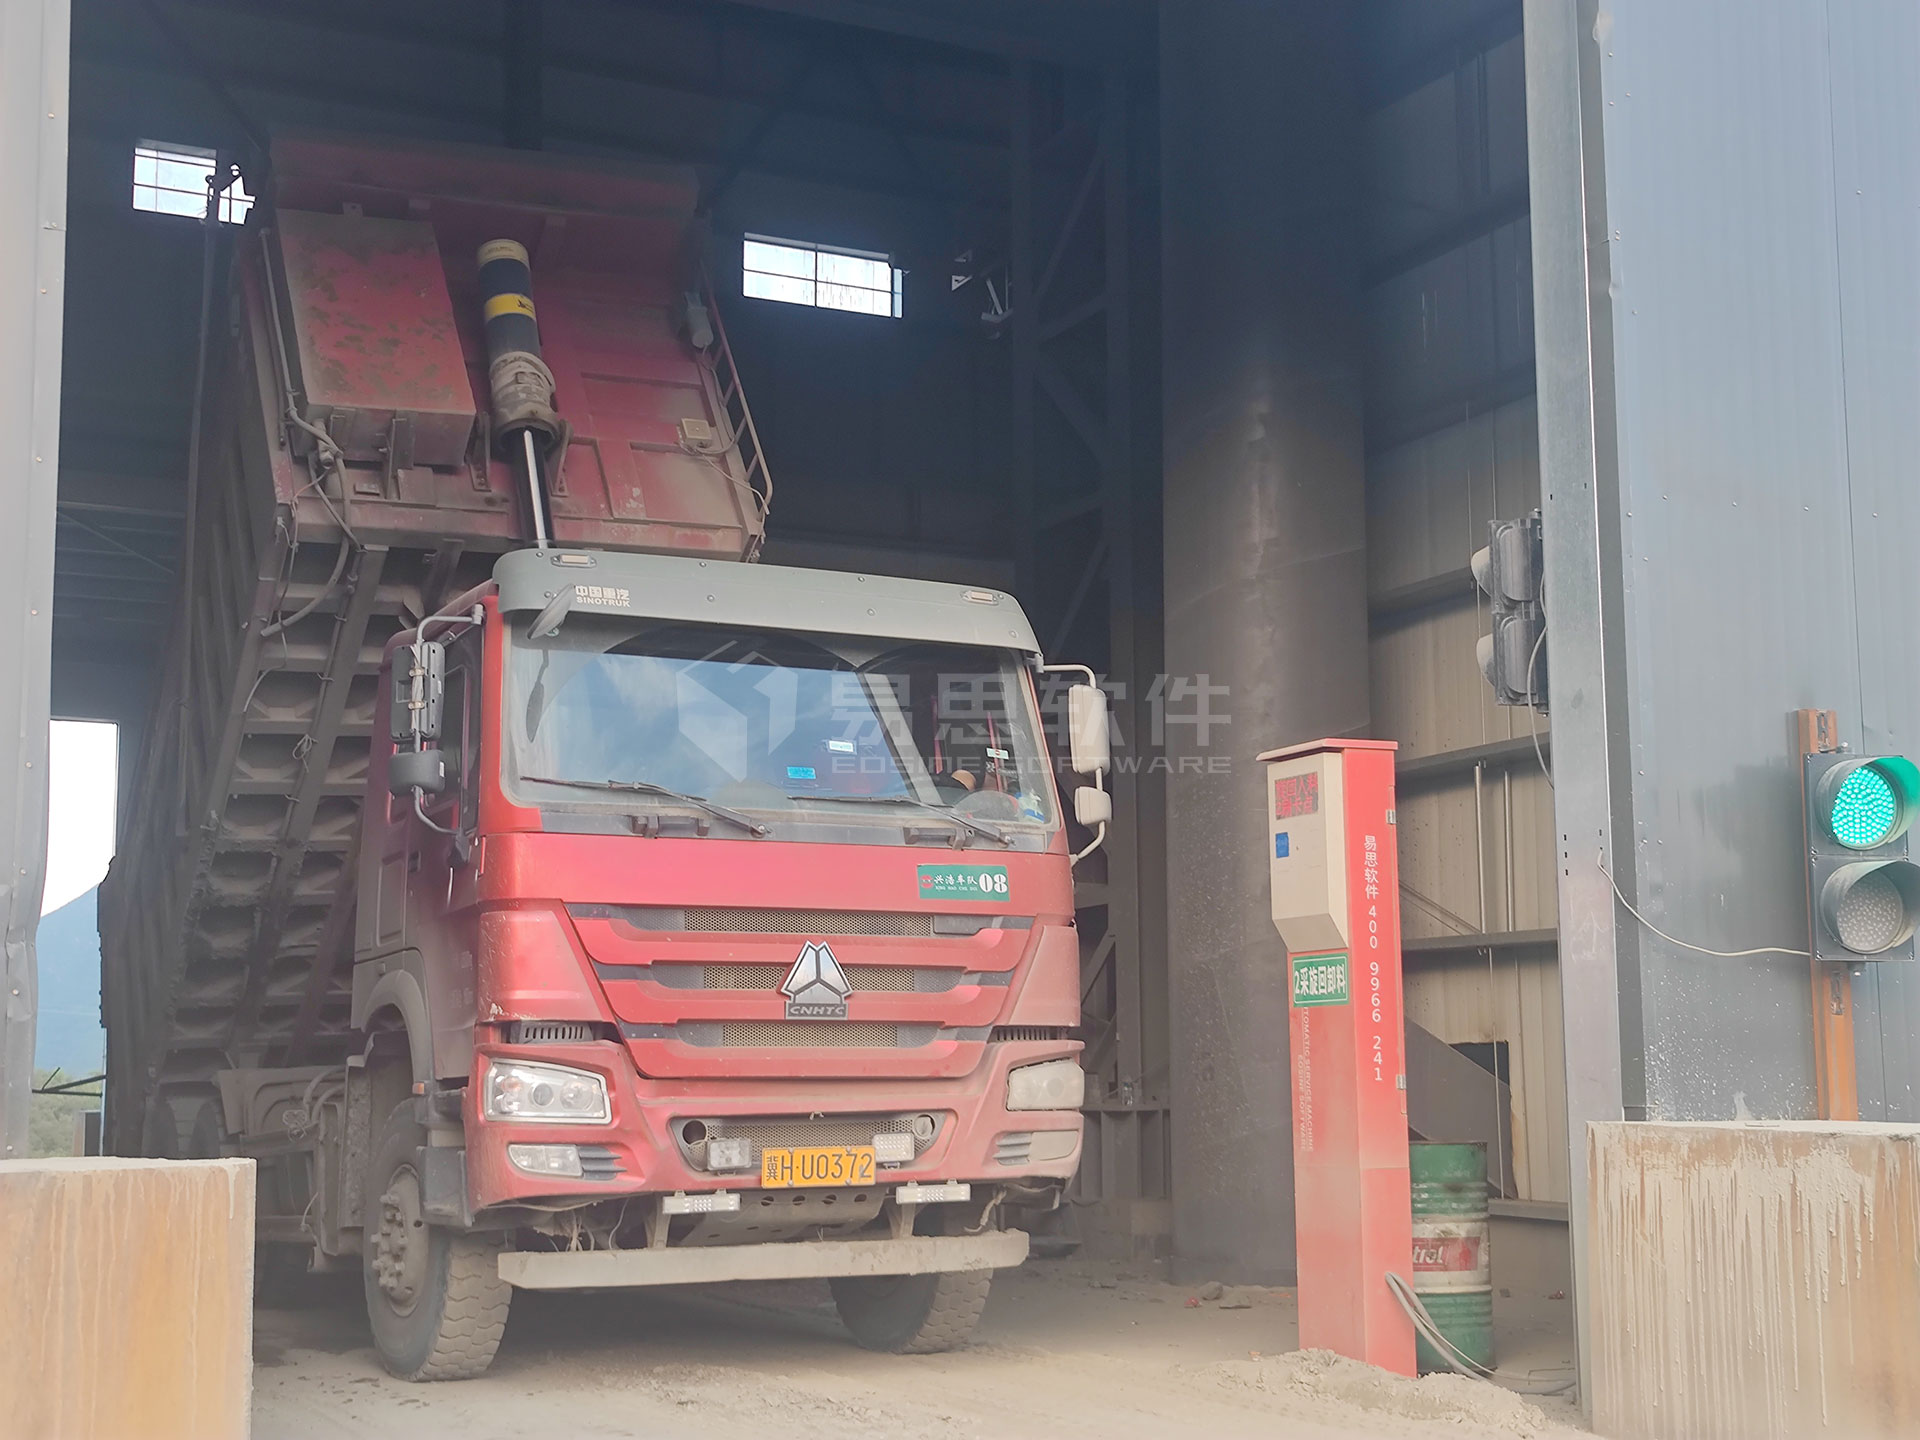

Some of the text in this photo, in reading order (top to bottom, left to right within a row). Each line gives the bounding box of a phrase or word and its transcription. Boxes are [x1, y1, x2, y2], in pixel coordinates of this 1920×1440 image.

[576, 596, 630, 607] SINOTRUK
[979, 873, 1008, 893] 08
[1364, 835, 1383, 1081] 易思软件 400 9966 241
[1294, 964, 1346, 995] 2采旋回卸料
[790, 1006, 844, 1015] CNHTC
[1413, 1246, 1443, 1264] trol
